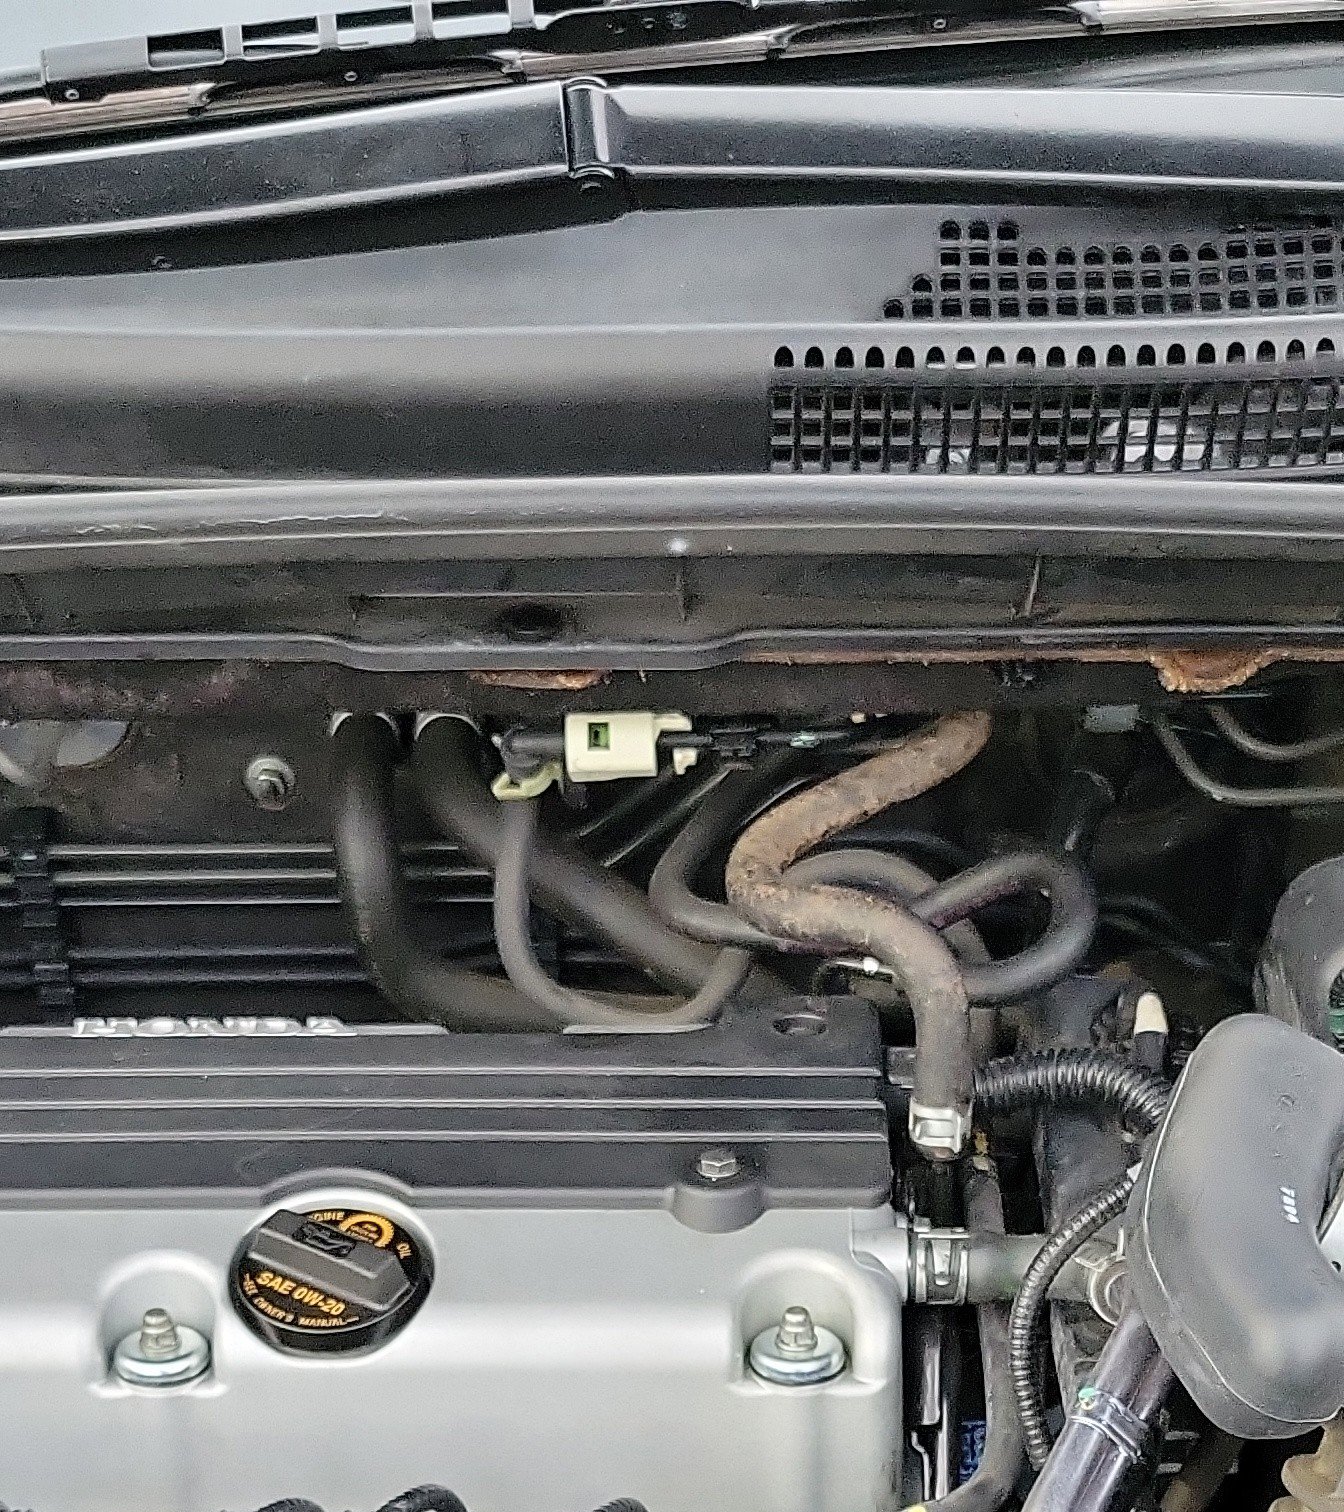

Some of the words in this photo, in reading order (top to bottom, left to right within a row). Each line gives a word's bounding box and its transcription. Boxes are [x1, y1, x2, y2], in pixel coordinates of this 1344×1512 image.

[397, 1243, 413, 1259] OIL
[256, 1270, 297, 1295] SAE
[291, 1286, 347, 1316] 0W-20
